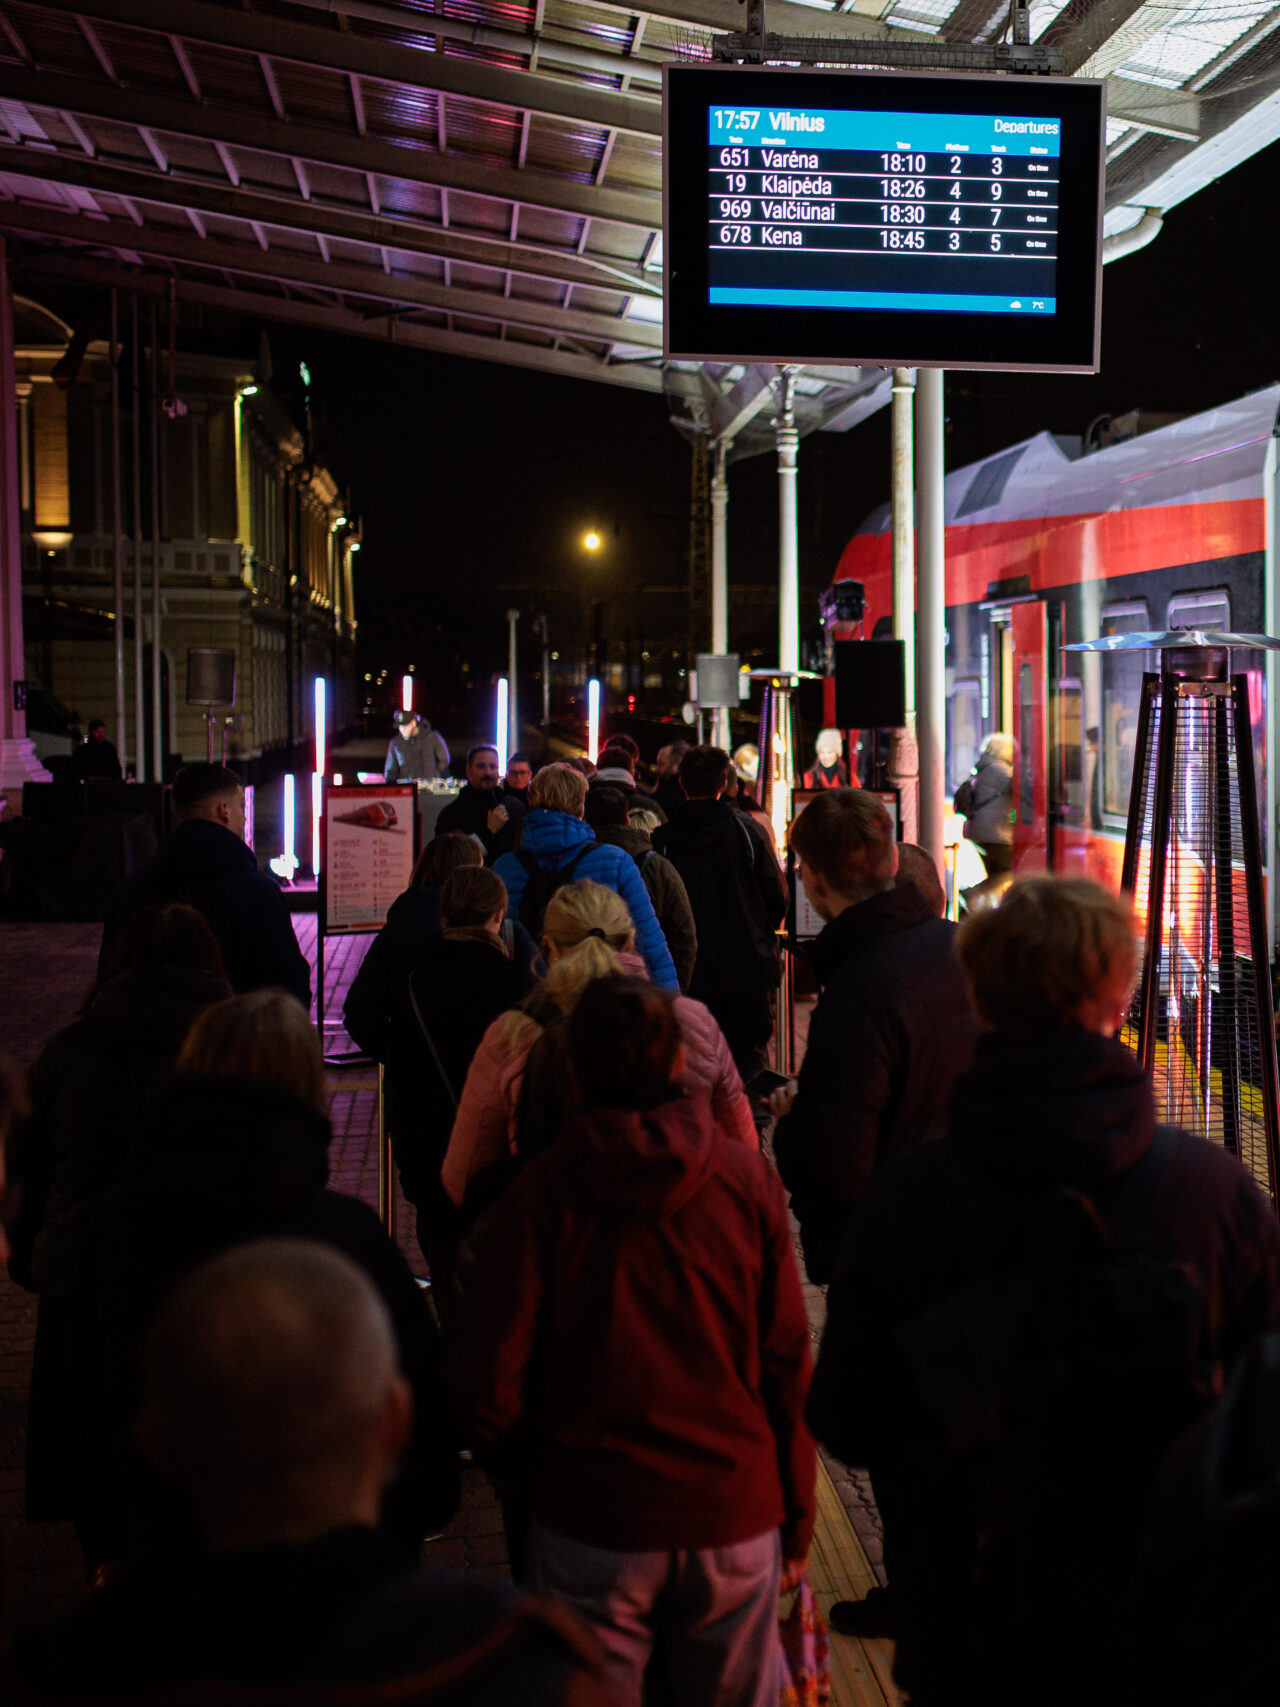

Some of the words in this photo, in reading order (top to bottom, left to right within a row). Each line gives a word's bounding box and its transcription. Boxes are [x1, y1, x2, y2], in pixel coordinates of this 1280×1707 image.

[714, 110, 760, 130] 17:57
[769, 111, 825, 132] Vilnius
[994, 119, 1059, 135] Departures
[720, 147, 749, 167] 651
[761, 149, 819, 169] Varėna
[881, 153, 926, 173] 18:10
[950, 155, 962, 174] 2
[991, 157, 1003, 175] 3
[726, 174, 746, 192] 19
[762, 175, 832, 198] Klaipėda
[880, 179, 926, 198] 18:26
[949, 181, 962, 200] 4
[990, 182, 1002, 201] 9
[720, 199, 751, 218] 969
[761, 200, 835, 221] Valčiūnai
[880, 204, 925, 224] 18:30
[949, 207, 961, 225] 4
[990, 208, 1002, 226] 7
[720, 225, 751, 244] 678
[761, 226, 803, 246] Kena
[880, 230, 925, 249] 18:45
[949, 232, 960, 251] 3
[990, 233, 1002, 252] 5
